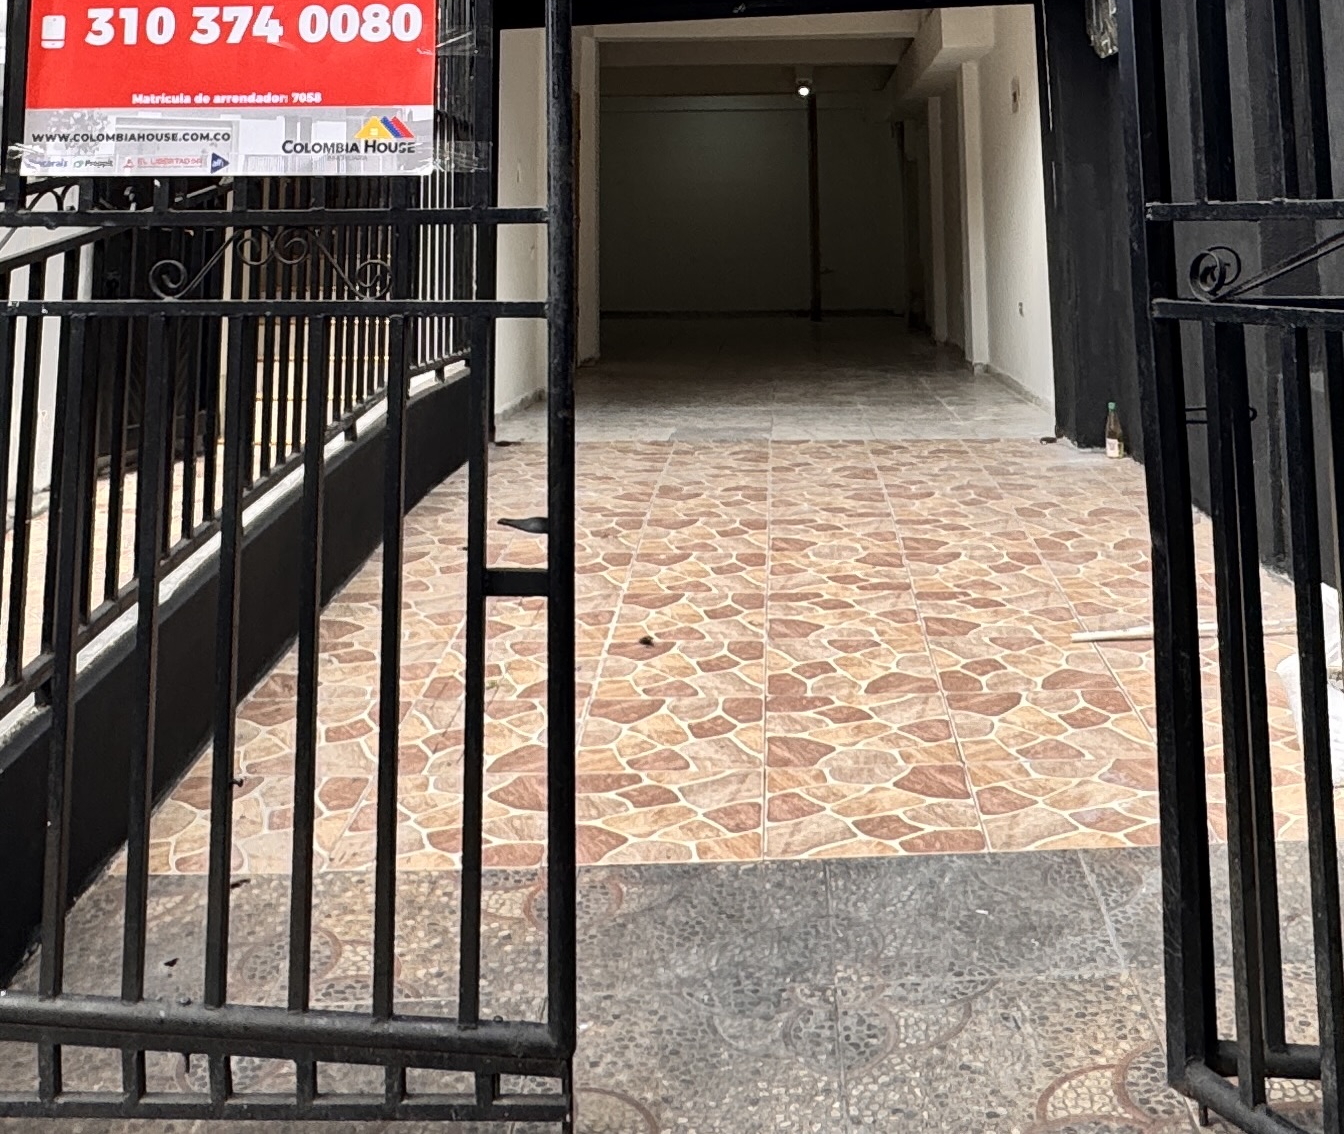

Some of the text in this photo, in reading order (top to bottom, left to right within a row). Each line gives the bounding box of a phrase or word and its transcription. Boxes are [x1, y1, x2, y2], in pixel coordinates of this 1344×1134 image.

[85, 3, 423, 45] 310 374 0080
[194, 94, 211, 104] de
[32, 133, 231, 142] WWW.COLOMBIAHOUSE.COM.CO
[282, 140, 415, 154] COLOMBIA HOUSE
